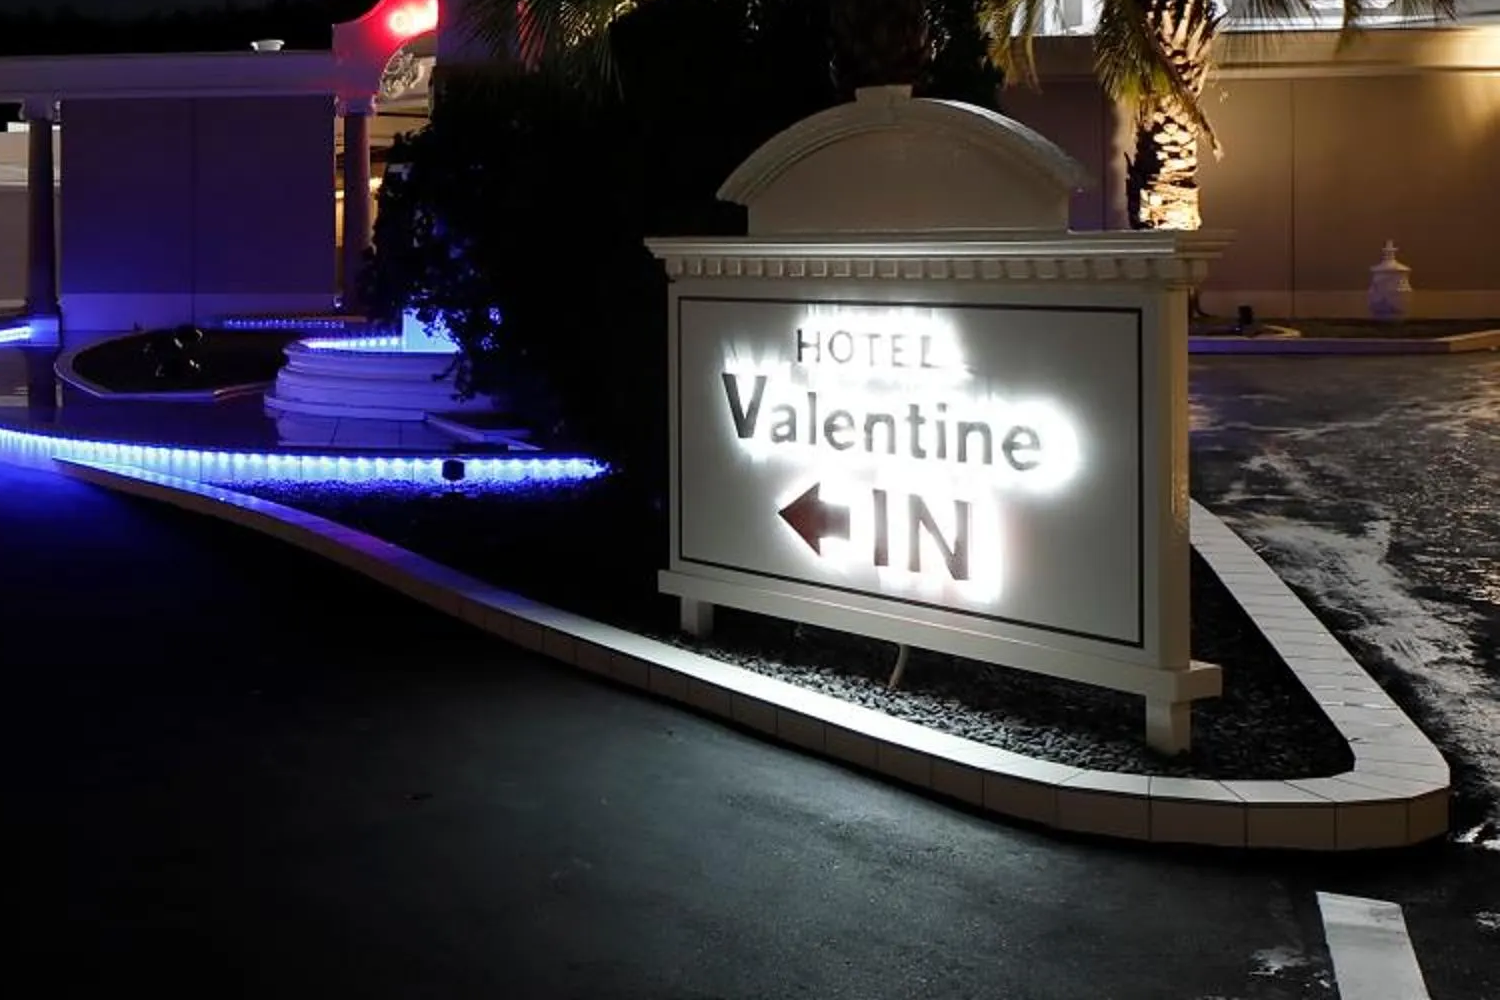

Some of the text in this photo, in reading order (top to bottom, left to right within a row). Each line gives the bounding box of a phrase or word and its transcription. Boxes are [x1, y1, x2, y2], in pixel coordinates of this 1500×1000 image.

[797, 328, 941, 368] HOTEL
[722, 373, 1043, 472] Valentine
[872, 489, 973, 582] IN
